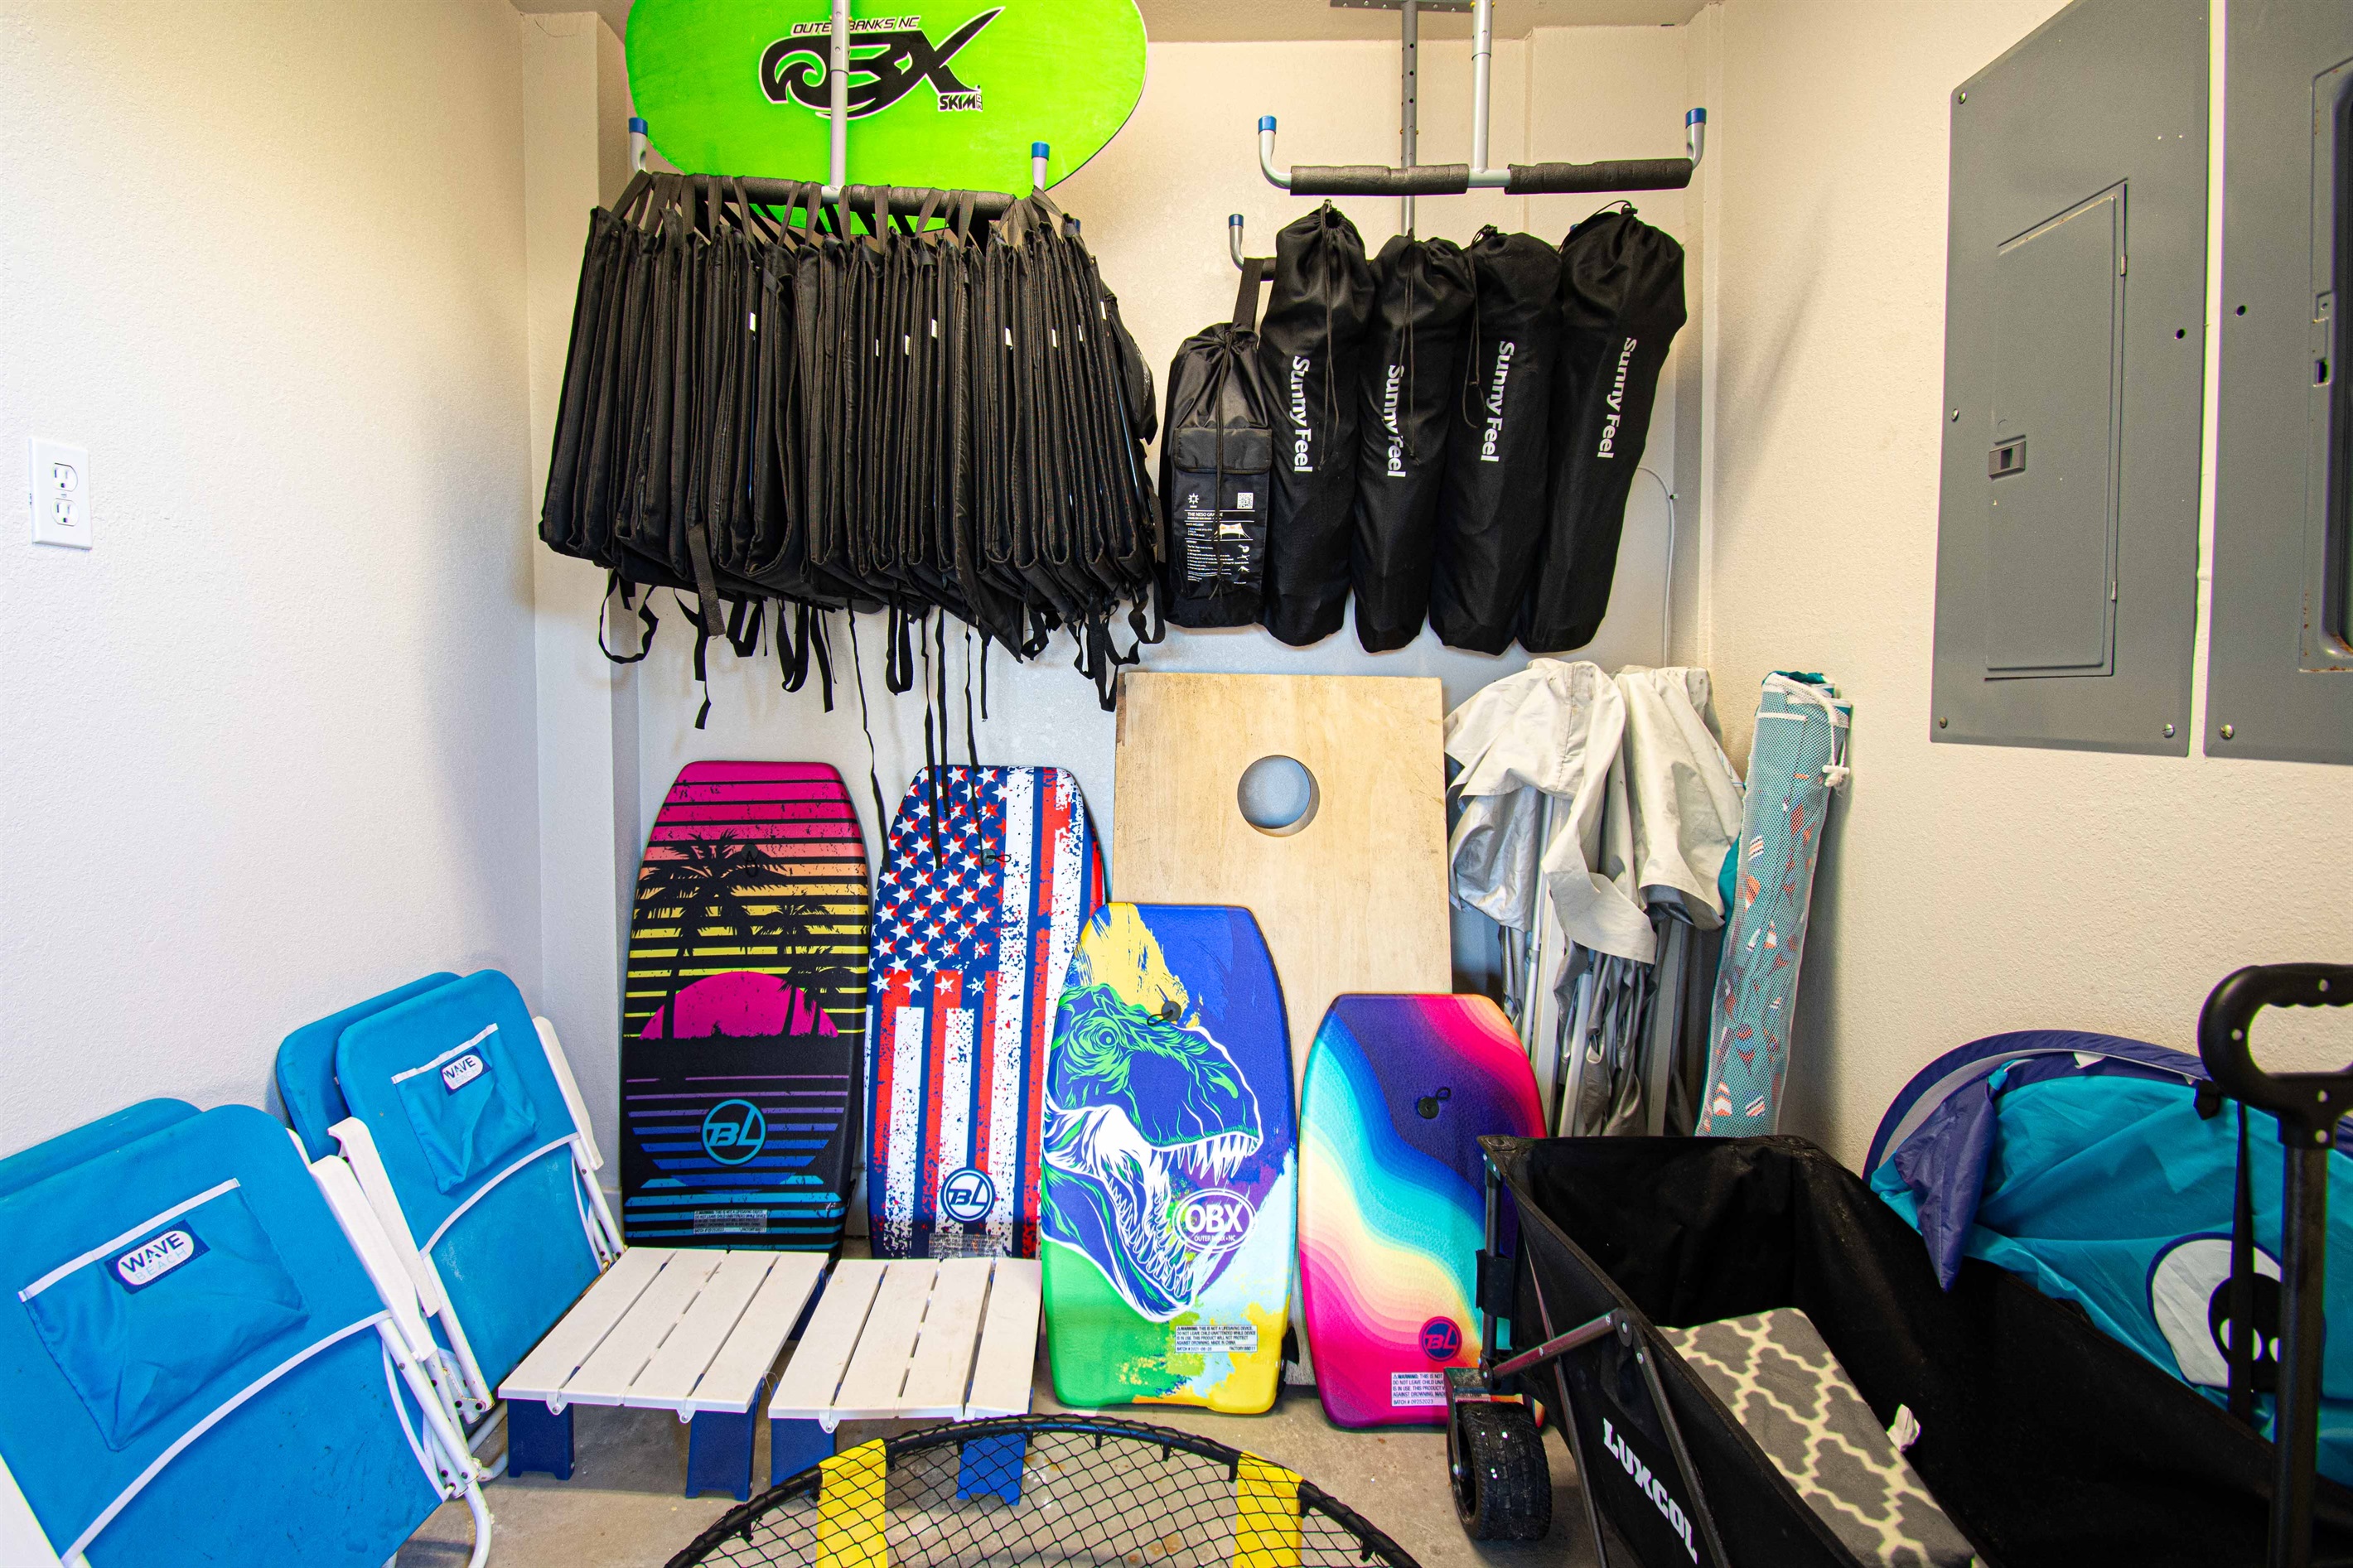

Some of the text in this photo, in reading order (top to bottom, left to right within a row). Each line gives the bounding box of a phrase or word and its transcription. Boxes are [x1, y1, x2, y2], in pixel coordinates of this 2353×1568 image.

[792, 17, 920, 34] OUTE BANKS NC
[939, 94, 976, 110] SKIM
[1289, 355, 1313, 473] Sunny Feel
[1481, 340, 1515, 462] Sunny Feel
[1597, 337, 1637, 459] Sunny Feel
[1380, 364, 1407, 478] Sunny Feel
[443, 1056, 476, 1080] WAVE
[1185, 1204, 1244, 1233] OBX
[120, 1233, 185, 1273] WAVE
[134, 1247, 187, 1281] BEACH
[1602, 1417, 1698, 1565] LUXCOL
